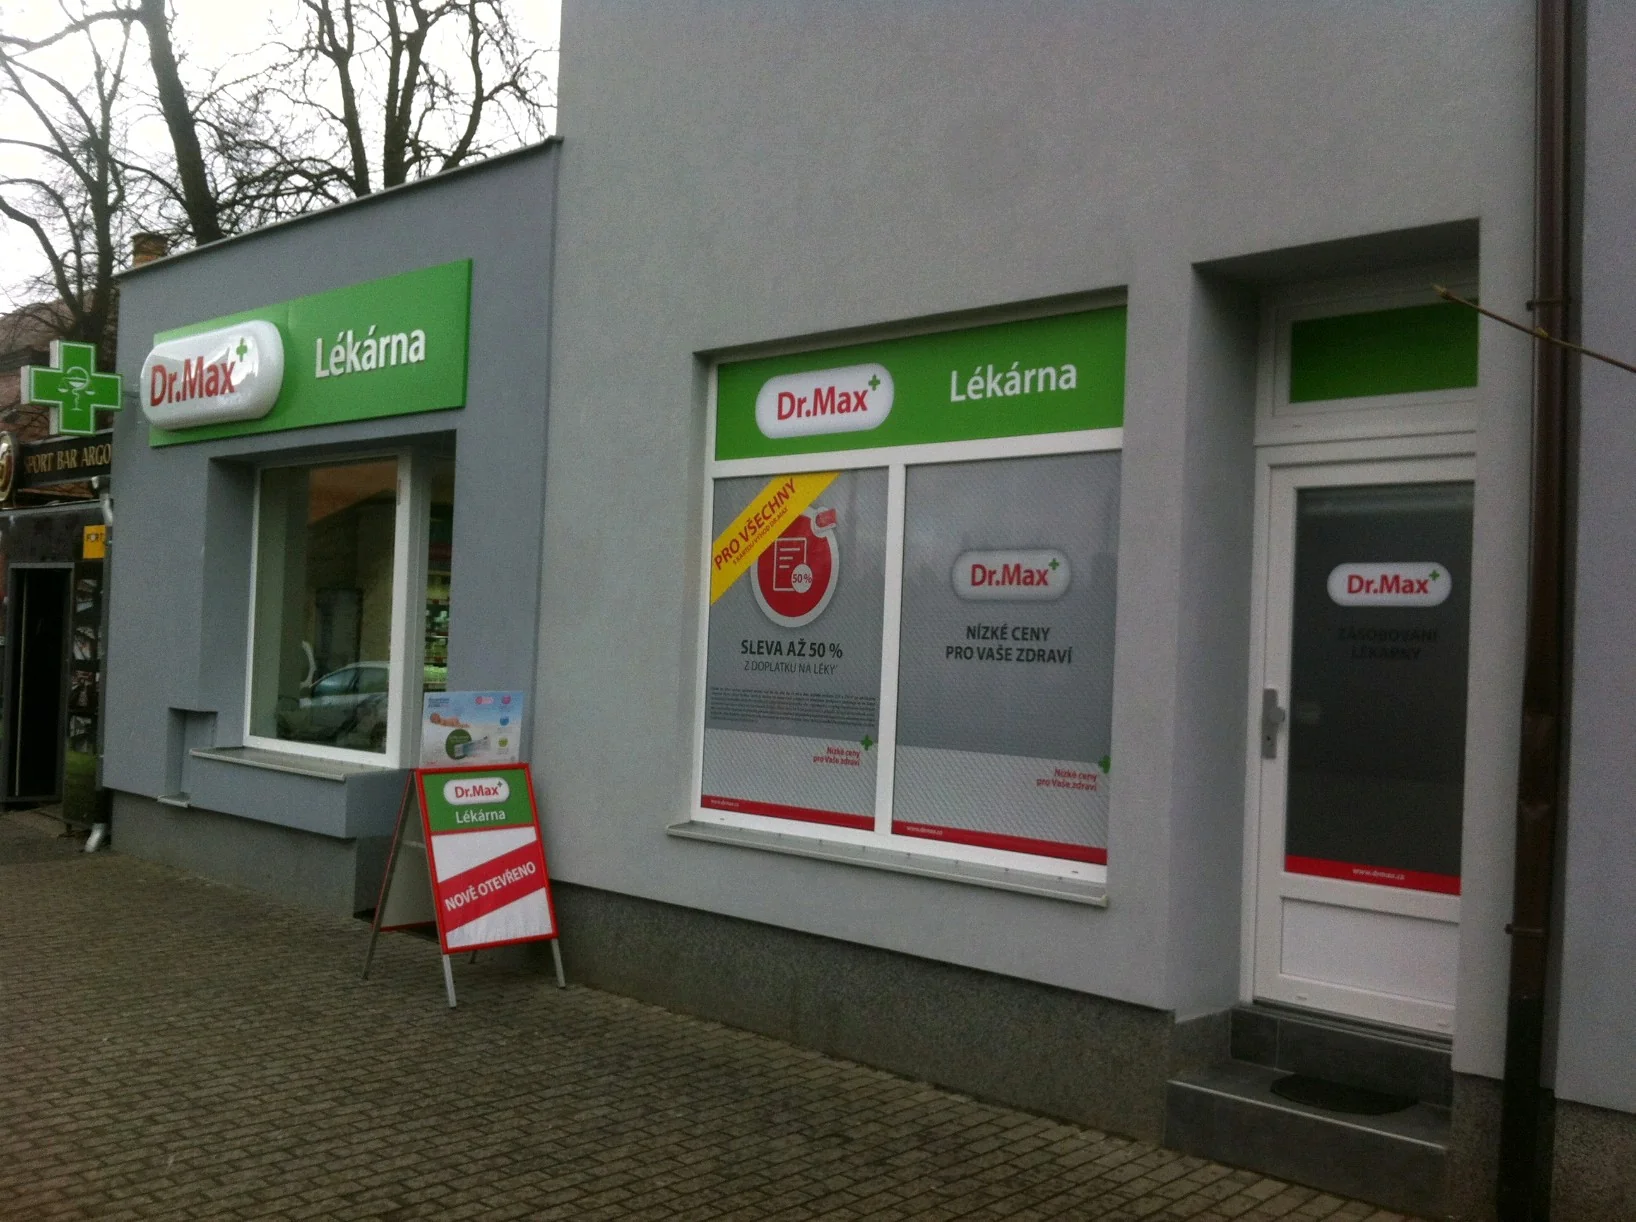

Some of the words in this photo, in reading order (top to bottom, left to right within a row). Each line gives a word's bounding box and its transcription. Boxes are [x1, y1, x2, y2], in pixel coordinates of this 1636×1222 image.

[150, 354, 238, 406] Dr.Max
[314, 325, 426, 379] Lékárna
[776, 386, 869, 421] Dr.Max
[950, 361, 1077, 402] Lékárna
[57, 449, 77, 470] BAR
[713, 538, 740, 571] PRO
[739, 478, 797, 543] VŠECHNY
[970, 563, 1049, 587] Dr.Max
[1347, 574, 1430, 594] Dr.Max
[966, 622, 1008, 641] NÍZKÉ
[1011, 626, 1051, 642] CENY
[741, 639, 783, 657] SLEVA
[787, 638, 806, 658] AŽ
[946, 645, 974, 661] PRO
[976, 645, 1012, 662] VAŠE
[1016, 647, 1073, 664] ZDRAVÍ
[744, 660, 750, 671] Z
[751, 660, 797, 674] DOPLATKU
[799, 662, 812, 674] NA
[455, 784, 499, 799] Dr.Max
[455, 808, 506, 824] Lékárna
[478, 860, 536, 896] OTEVŘENO
